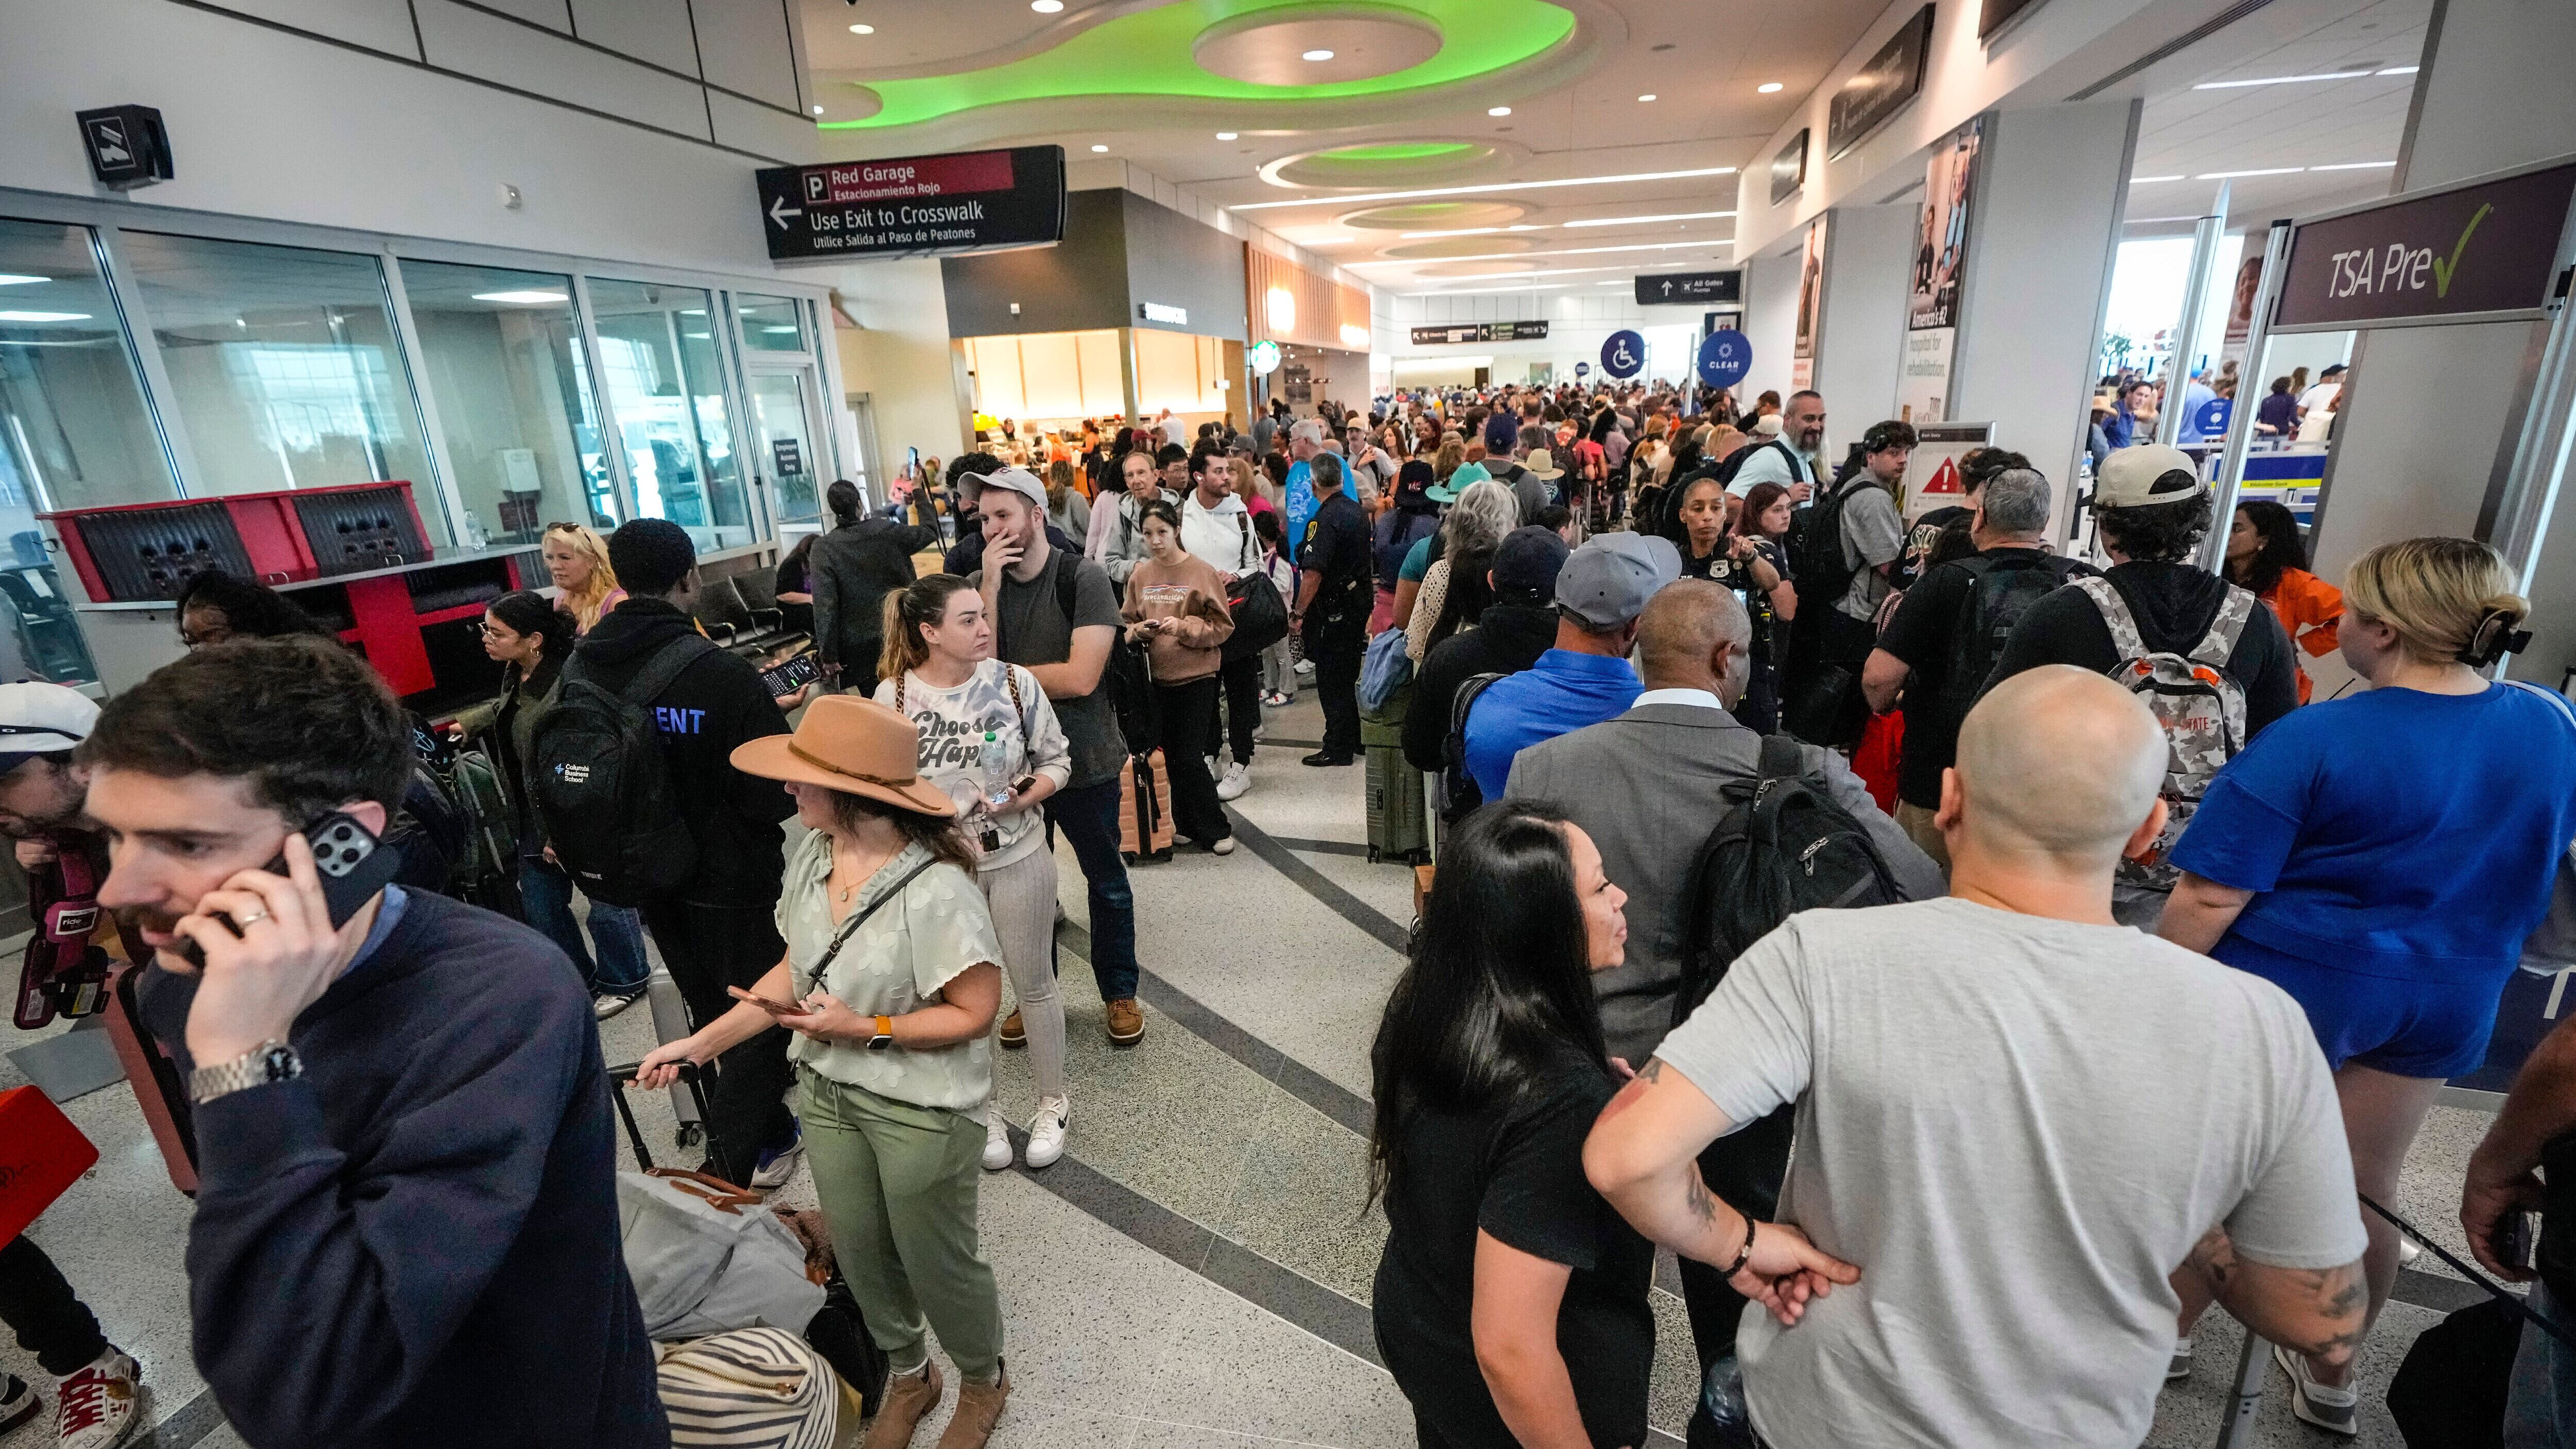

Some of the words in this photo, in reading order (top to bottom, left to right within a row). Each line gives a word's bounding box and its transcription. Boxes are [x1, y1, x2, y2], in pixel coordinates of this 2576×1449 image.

[832, 167, 859, 185] Red
[863, 166, 915, 183] Garage
[809, 176, 823, 198] P
[835, 185, 916, 201] Estacionamiento
[918, 181, 940, 196] Rojo
[810, 212, 840, 231] Use
[845, 208, 874, 228] Exit
[877, 208, 895, 226] to
[901, 200, 984, 224] Crosswalk
[813, 235, 843, 248] Utilice
[845, 233, 874, 246] Salida
[877, 232, 887, 245] al
[889, 231, 912, 243] Paso
[915, 229, 927, 242] de
[930, 228, 976, 241] Peatones
[2329, 247, 2374, 298] TSA
[2378, 243, 2432, 293] Pre
[1909, 333, 1933, 357] hospital
[1709, 361, 1739, 369] CLEAR
[784, 463, 795, 471] Only
[655, 706, 705, 734] ENT
[911, 710, 1007, 738] Choose
[2180, 717, 2210, 731] STATE
